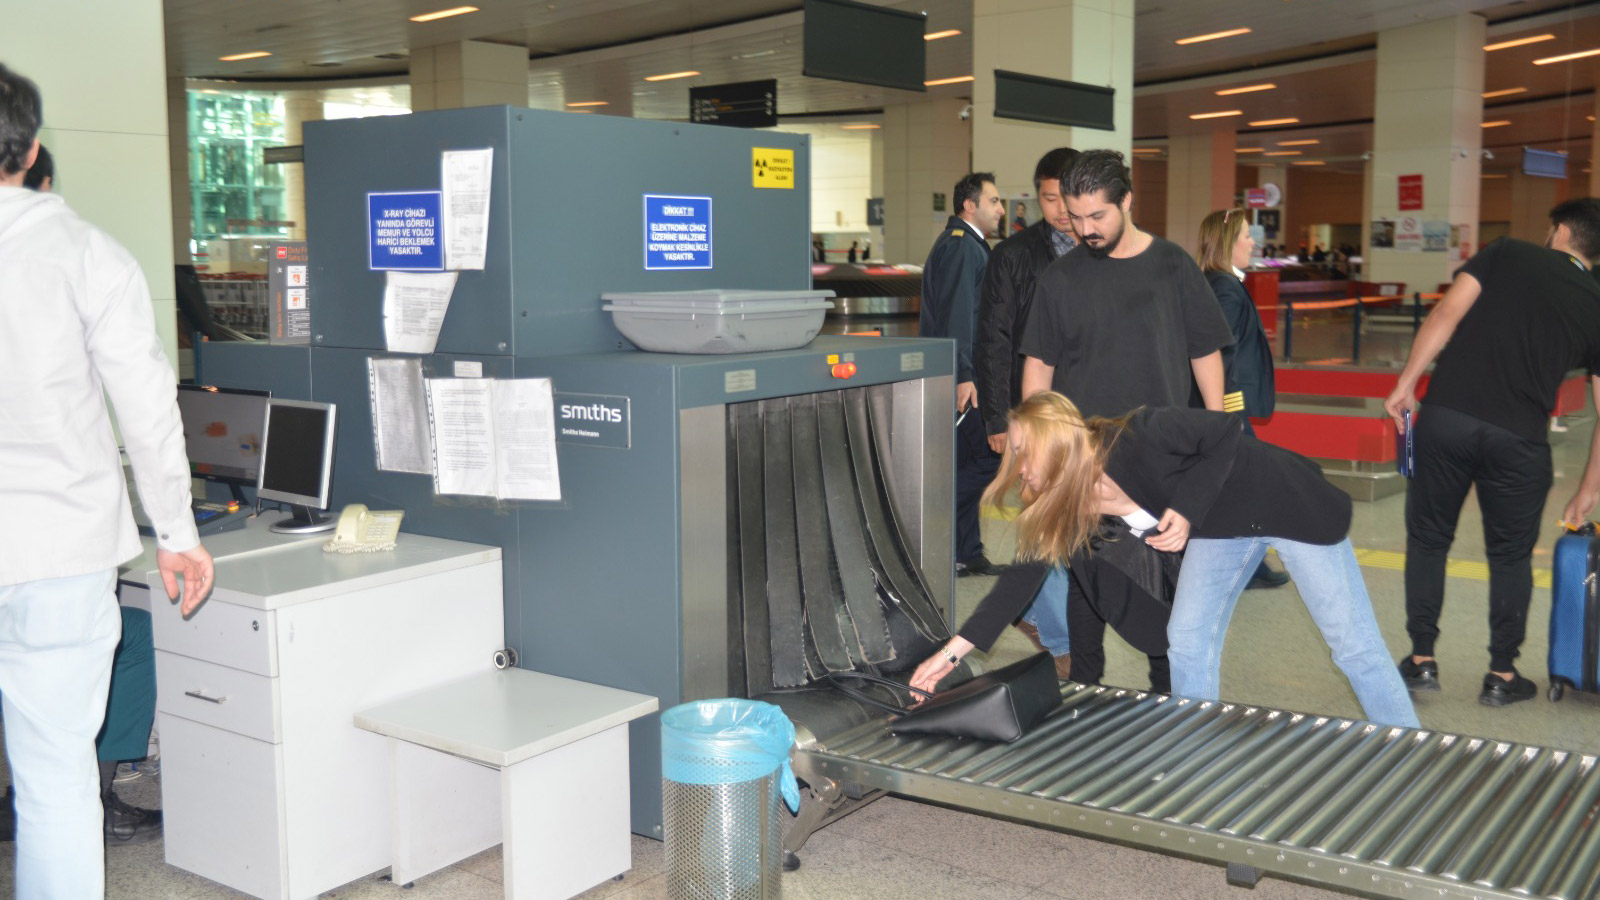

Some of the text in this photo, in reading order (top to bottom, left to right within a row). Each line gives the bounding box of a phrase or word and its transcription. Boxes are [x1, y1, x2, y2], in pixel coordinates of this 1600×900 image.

[384, 207, 426, 218] X-RAY CİHAZI
[663, 205, 687, 216] DİKKAT
[377, 217, 435, 228] YANINDA GÖREVLİ
[651, 222, 707, 232] ELEKTRONİK CİHAZ
[377, 228, 434, 237] MEMUR VE YOLCU
[651, 231, 707, 242] ÜZERİNE MALZEME
[377, 236, 435, 246] HARİCİ BEKLEMEK
[389, 246, 423, 255] YASAKTIR.
[649, 242, 709, 252] KOYMAK KESİNLİKLE
[663, 252, 696, 261] YASAKTIR.
[561, 403, 622, 423] smiths
[562, 428, 600, 437] Smiths Heimann
